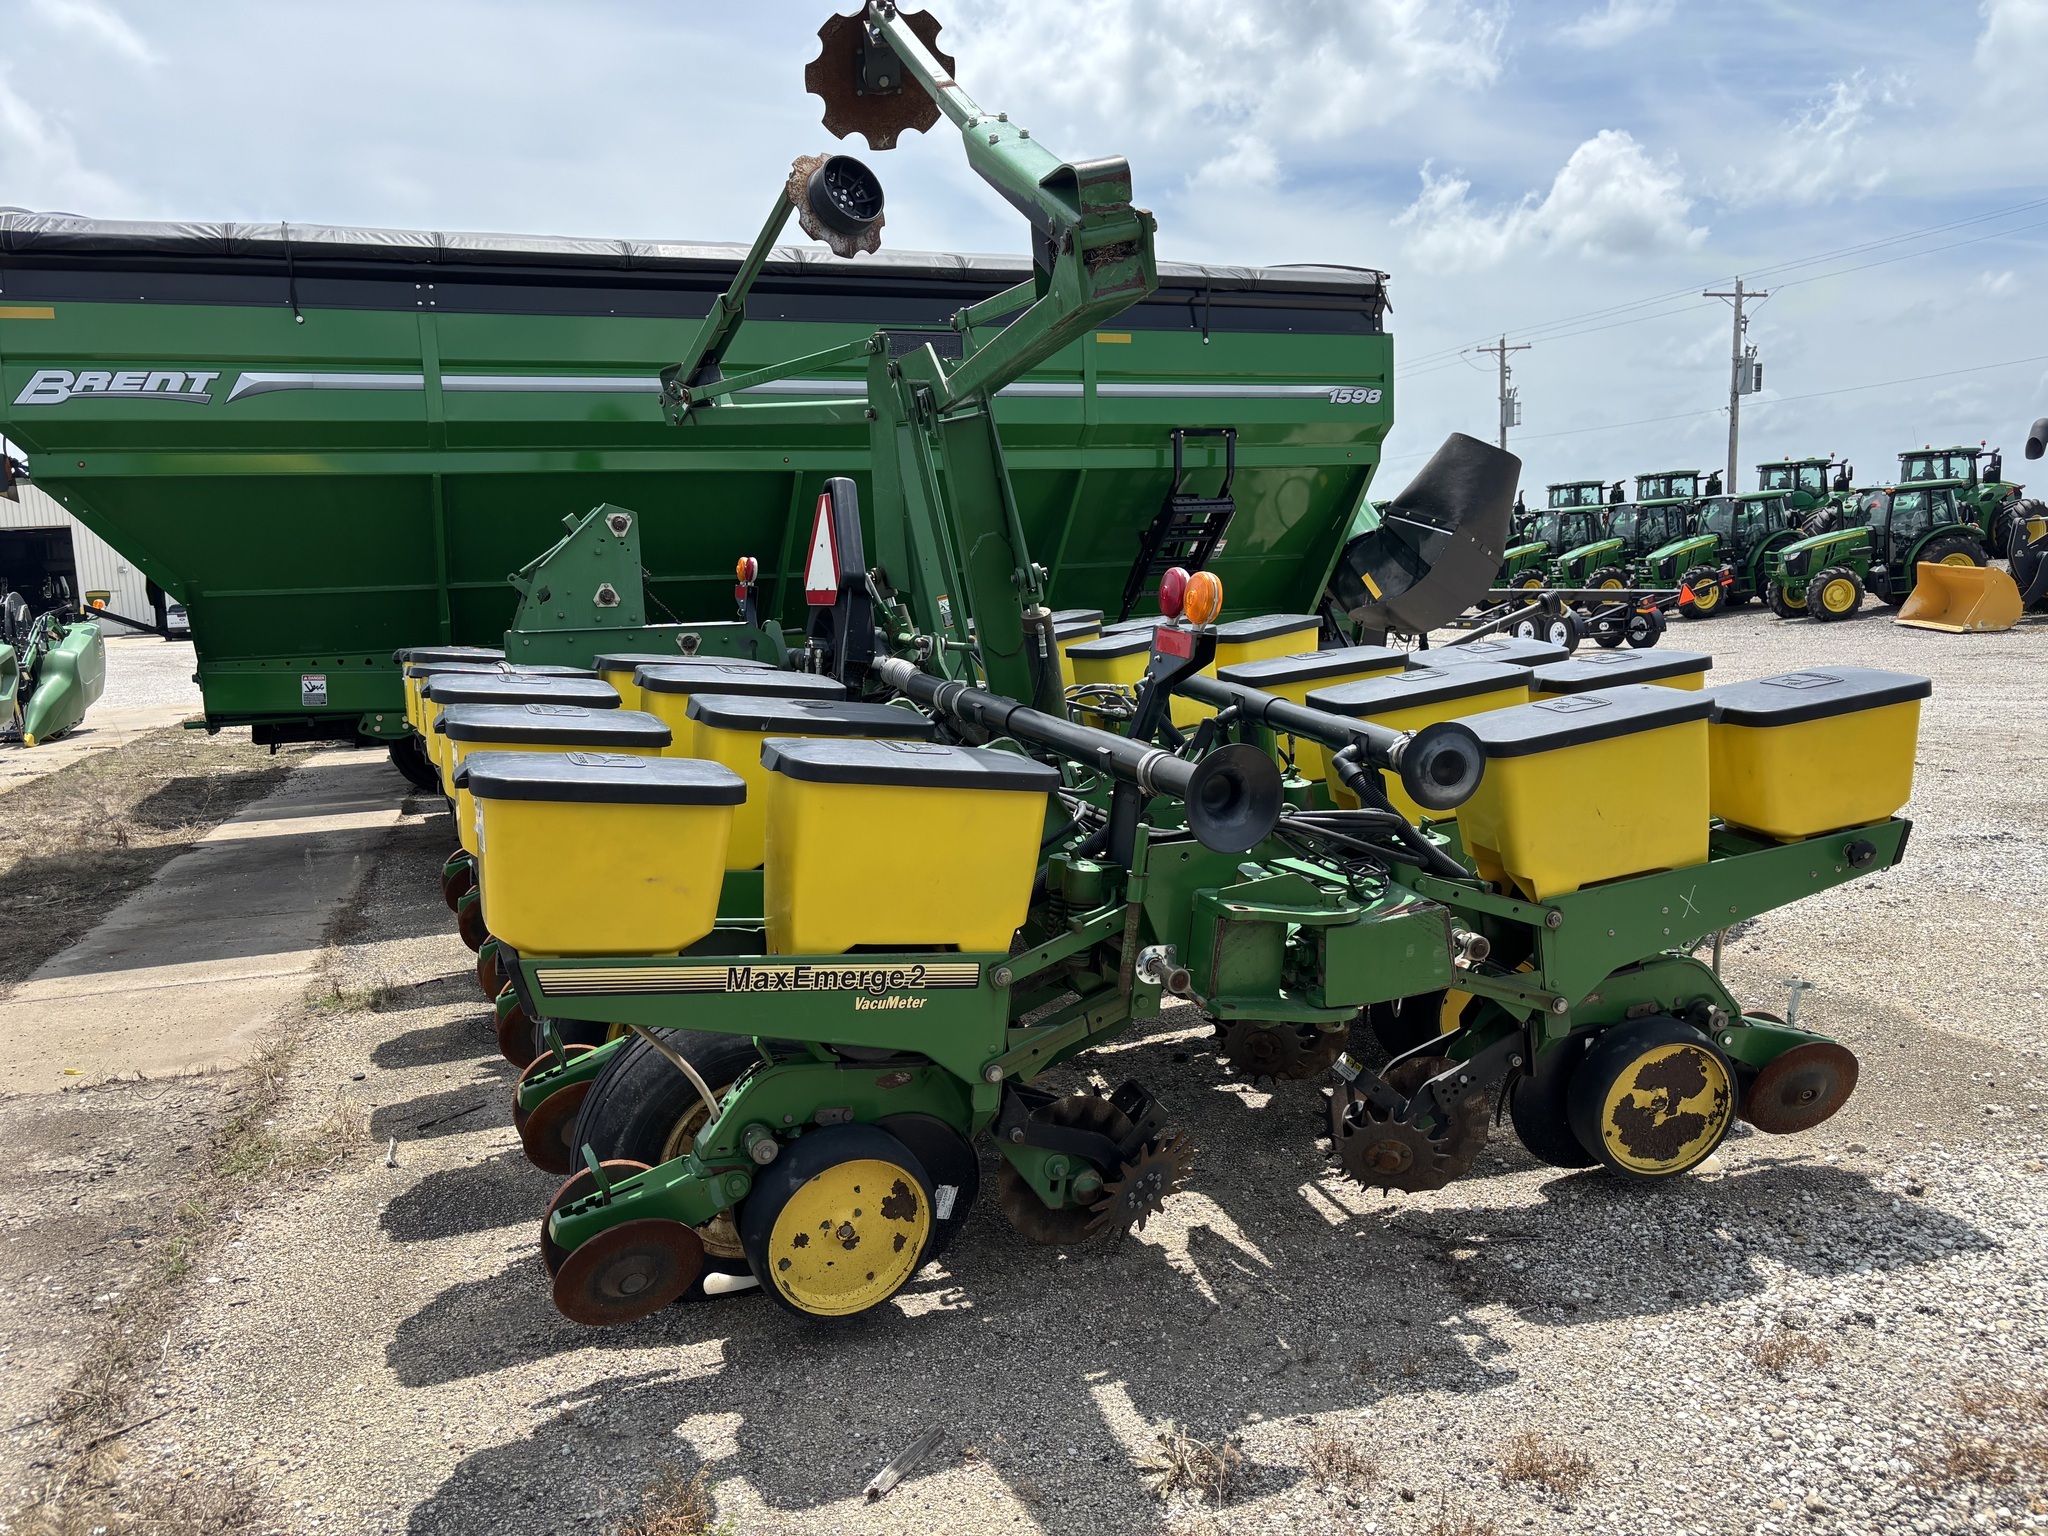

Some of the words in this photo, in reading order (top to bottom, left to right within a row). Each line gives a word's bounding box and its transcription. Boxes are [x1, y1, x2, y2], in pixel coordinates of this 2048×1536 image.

[1328, 389, 1383, 404] 1598
[726, 966, 905, 995] MaxEmerge
[909, 964, 926, 988] 2
[855, 995, 928, 1011] VacuMeter
